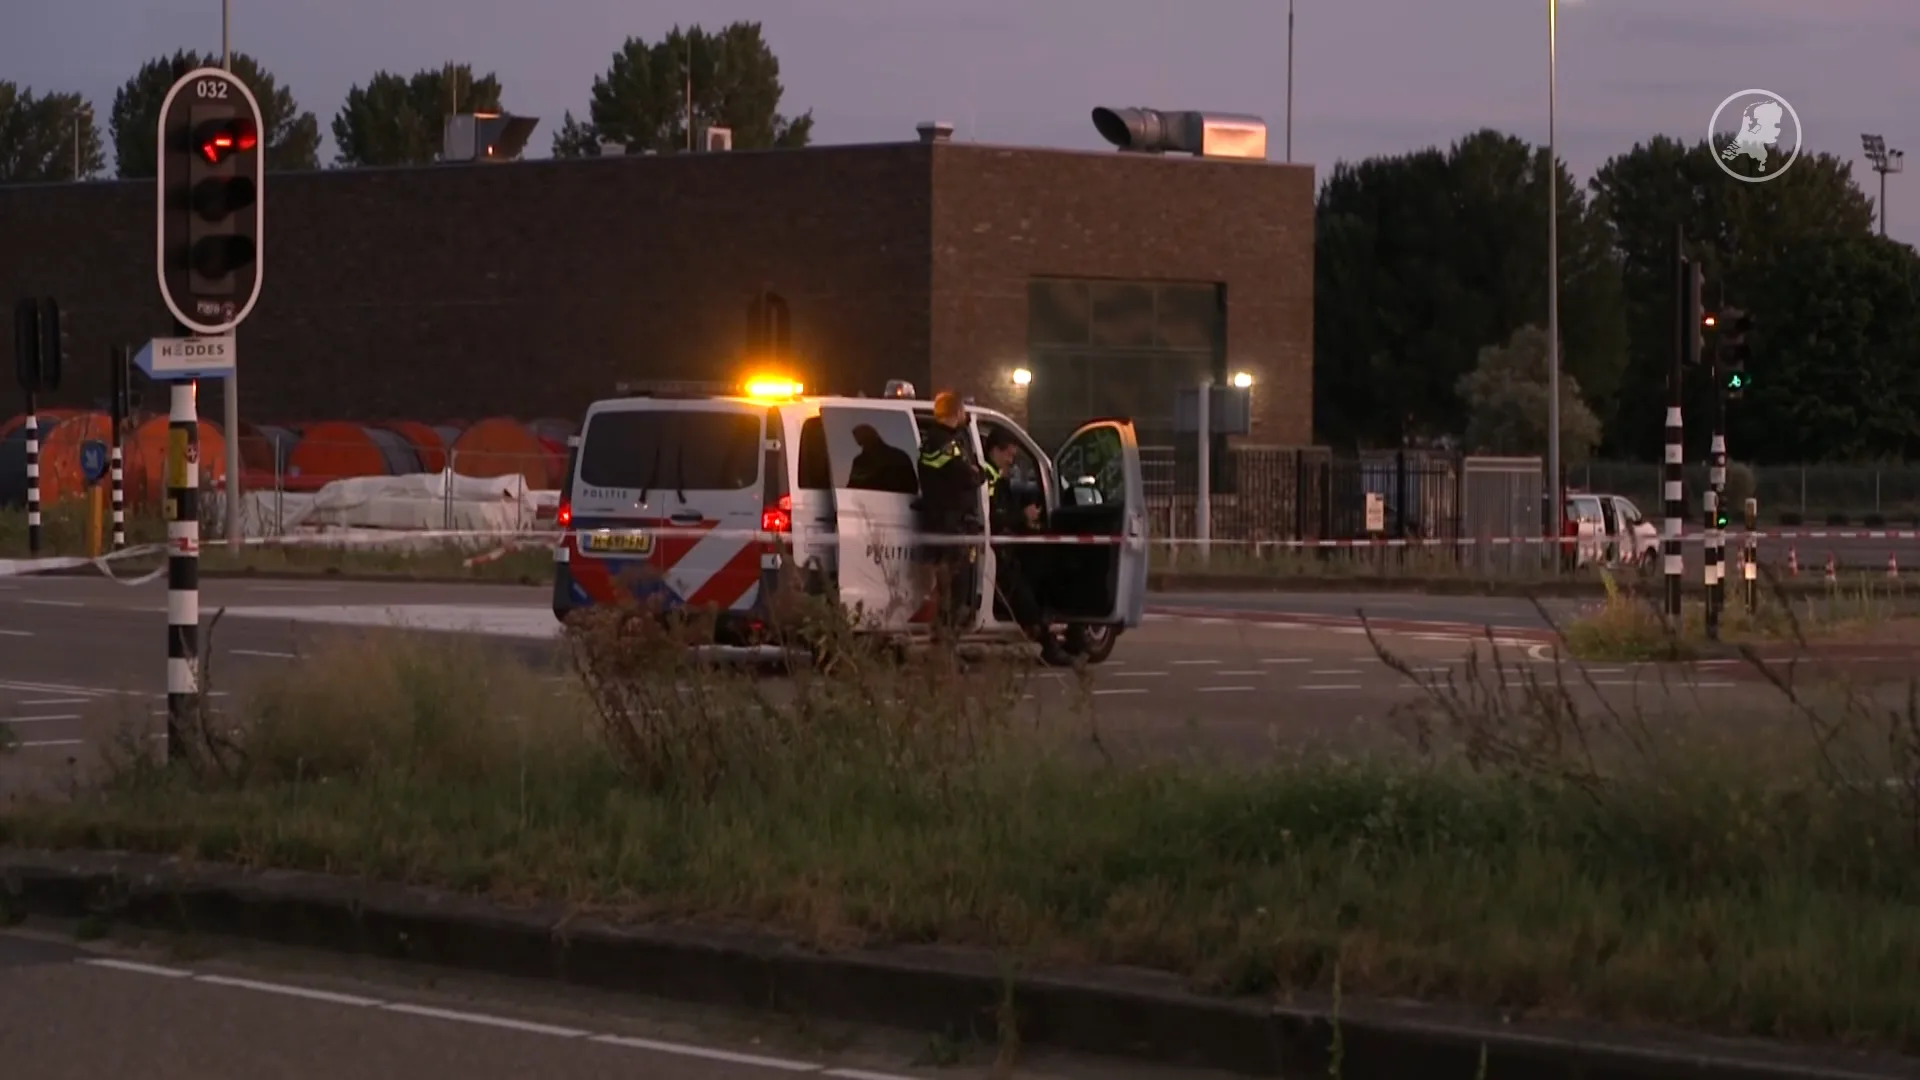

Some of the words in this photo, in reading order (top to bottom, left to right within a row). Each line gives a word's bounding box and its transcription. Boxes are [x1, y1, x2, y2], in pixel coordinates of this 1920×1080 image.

[197, 80, 228, 99] 032
[162, 344, 225, 357] HEDDES
[583, 488, 627, 499] POLITIE
